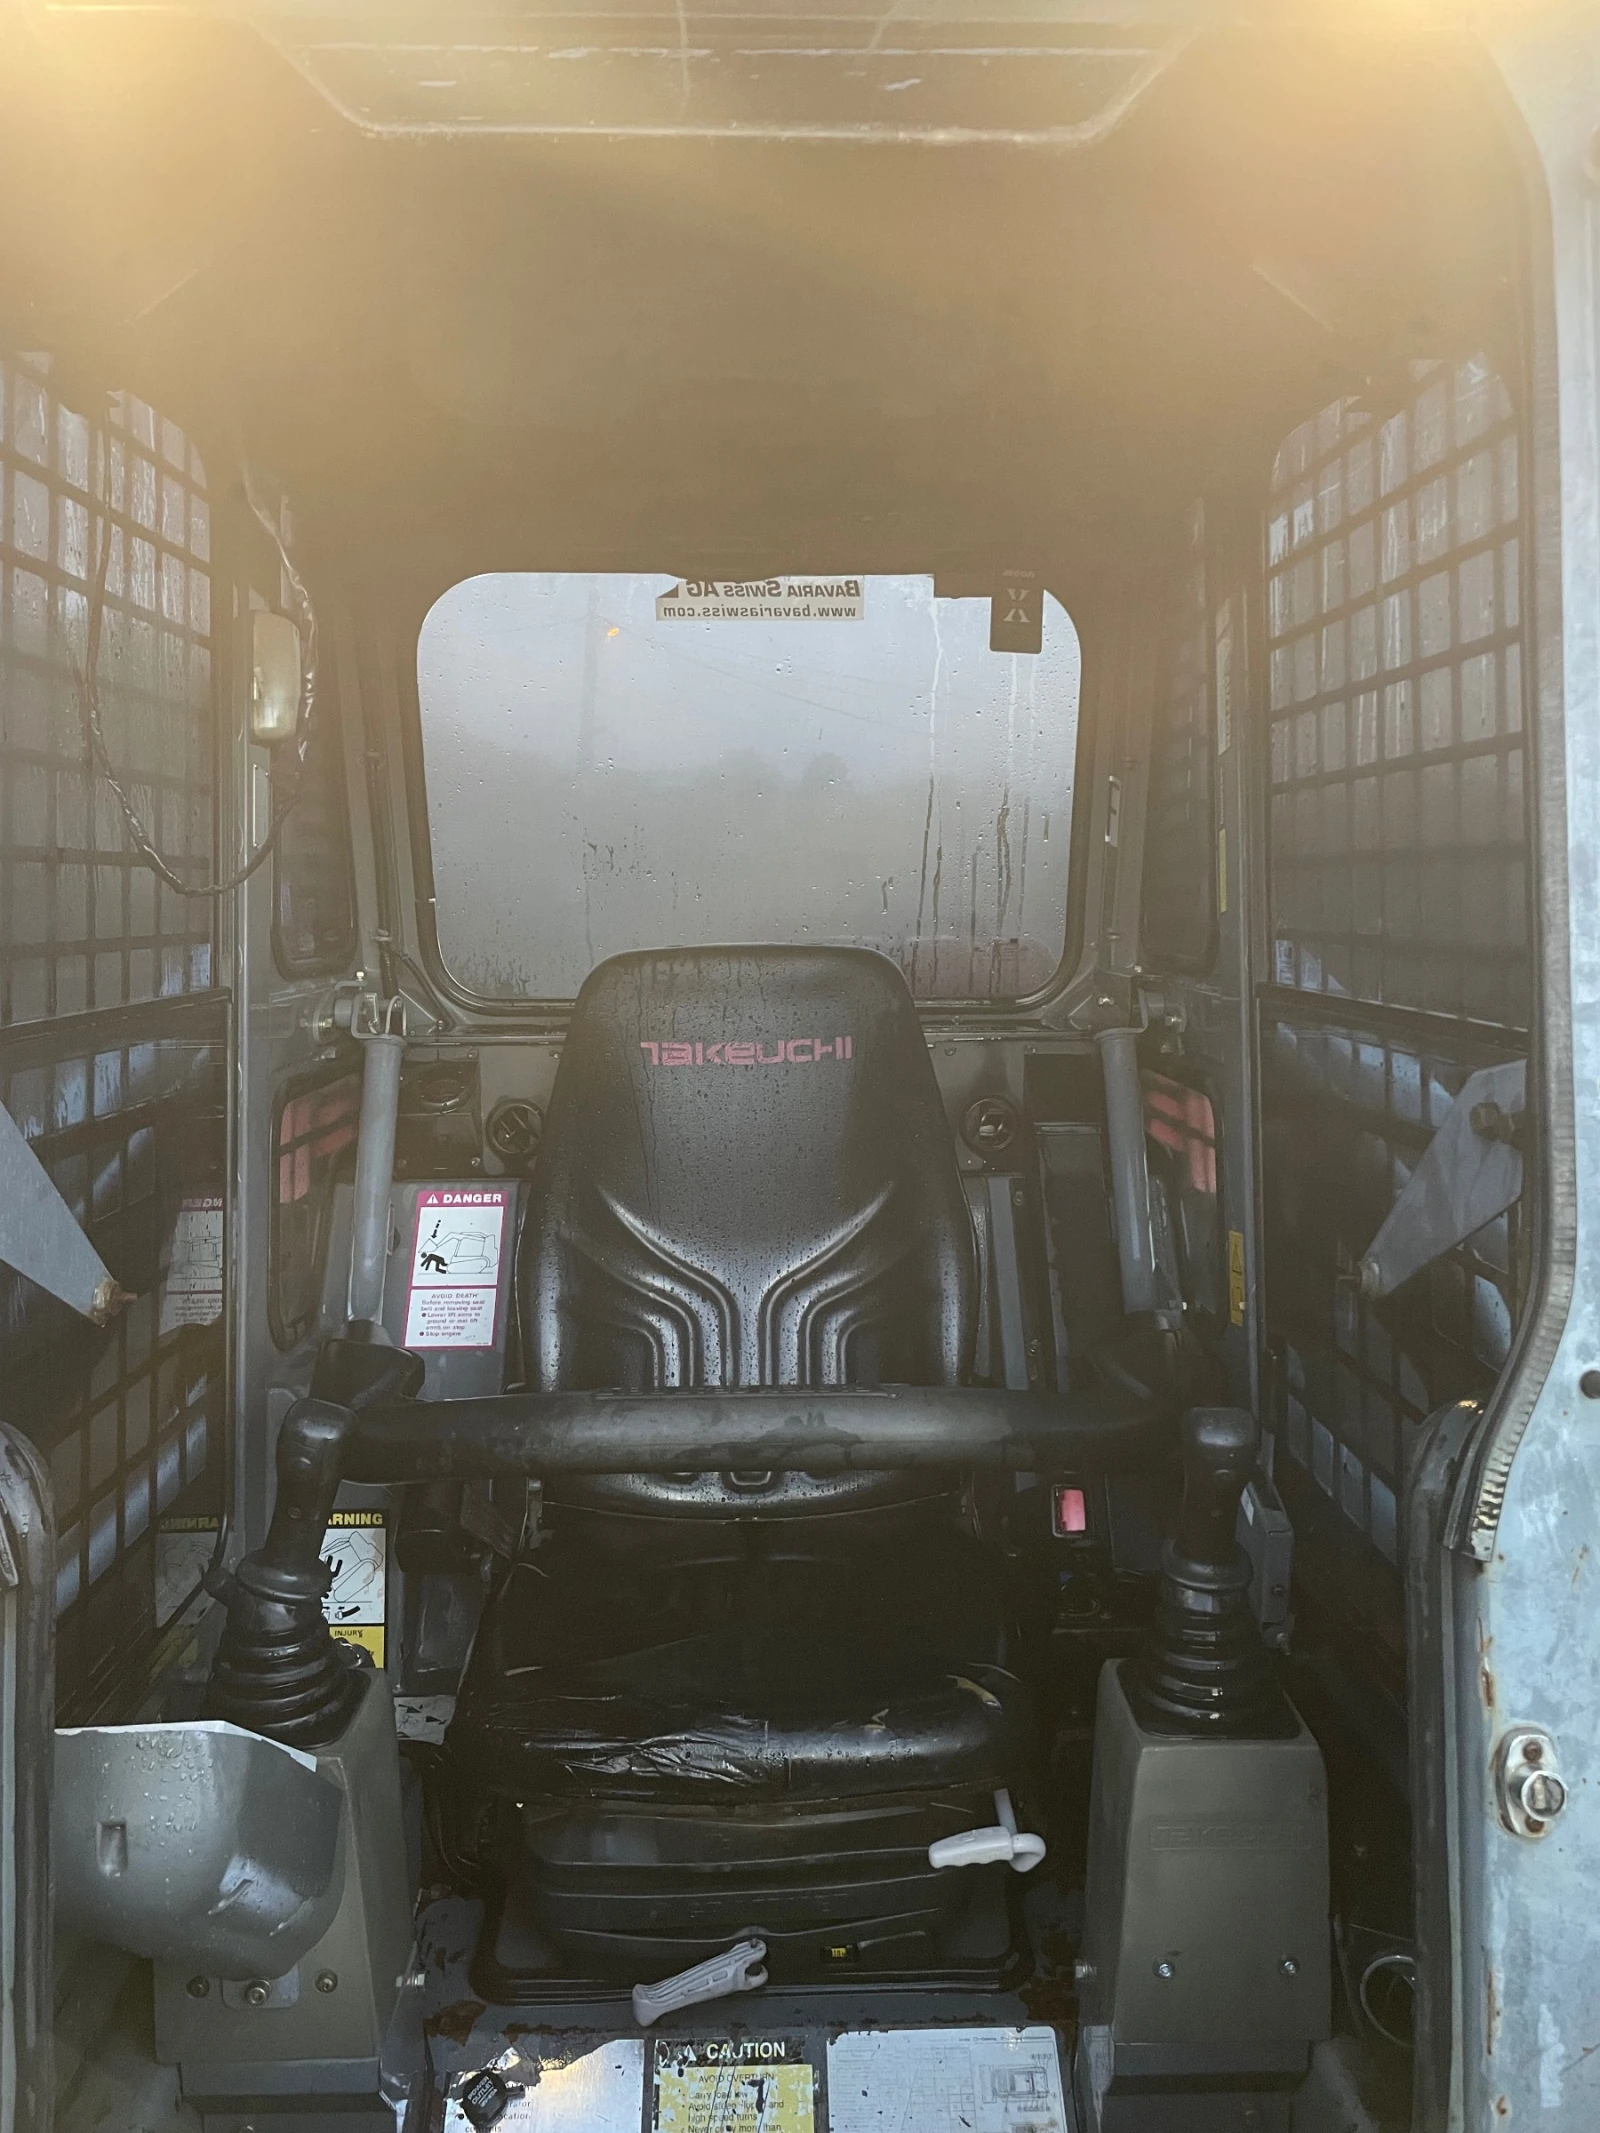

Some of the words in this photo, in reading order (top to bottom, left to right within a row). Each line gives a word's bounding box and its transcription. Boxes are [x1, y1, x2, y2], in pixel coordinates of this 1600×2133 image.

[640, 1035, 852, 1066] TAKEUCHI
[442, 1193, 503, 1204] DANGER
[327, 1513, 384, 1525] RNING
[334, 1629, 363, 1637] INJURY
[698, 2075, 725, 2083] AVOID
[468, 2076, 490, 2100] POWER
[471, 2081, 494, 2105] OUTLET
[769, 2100, 784, 2108] and
[688, 2113, 706, 2124] high
